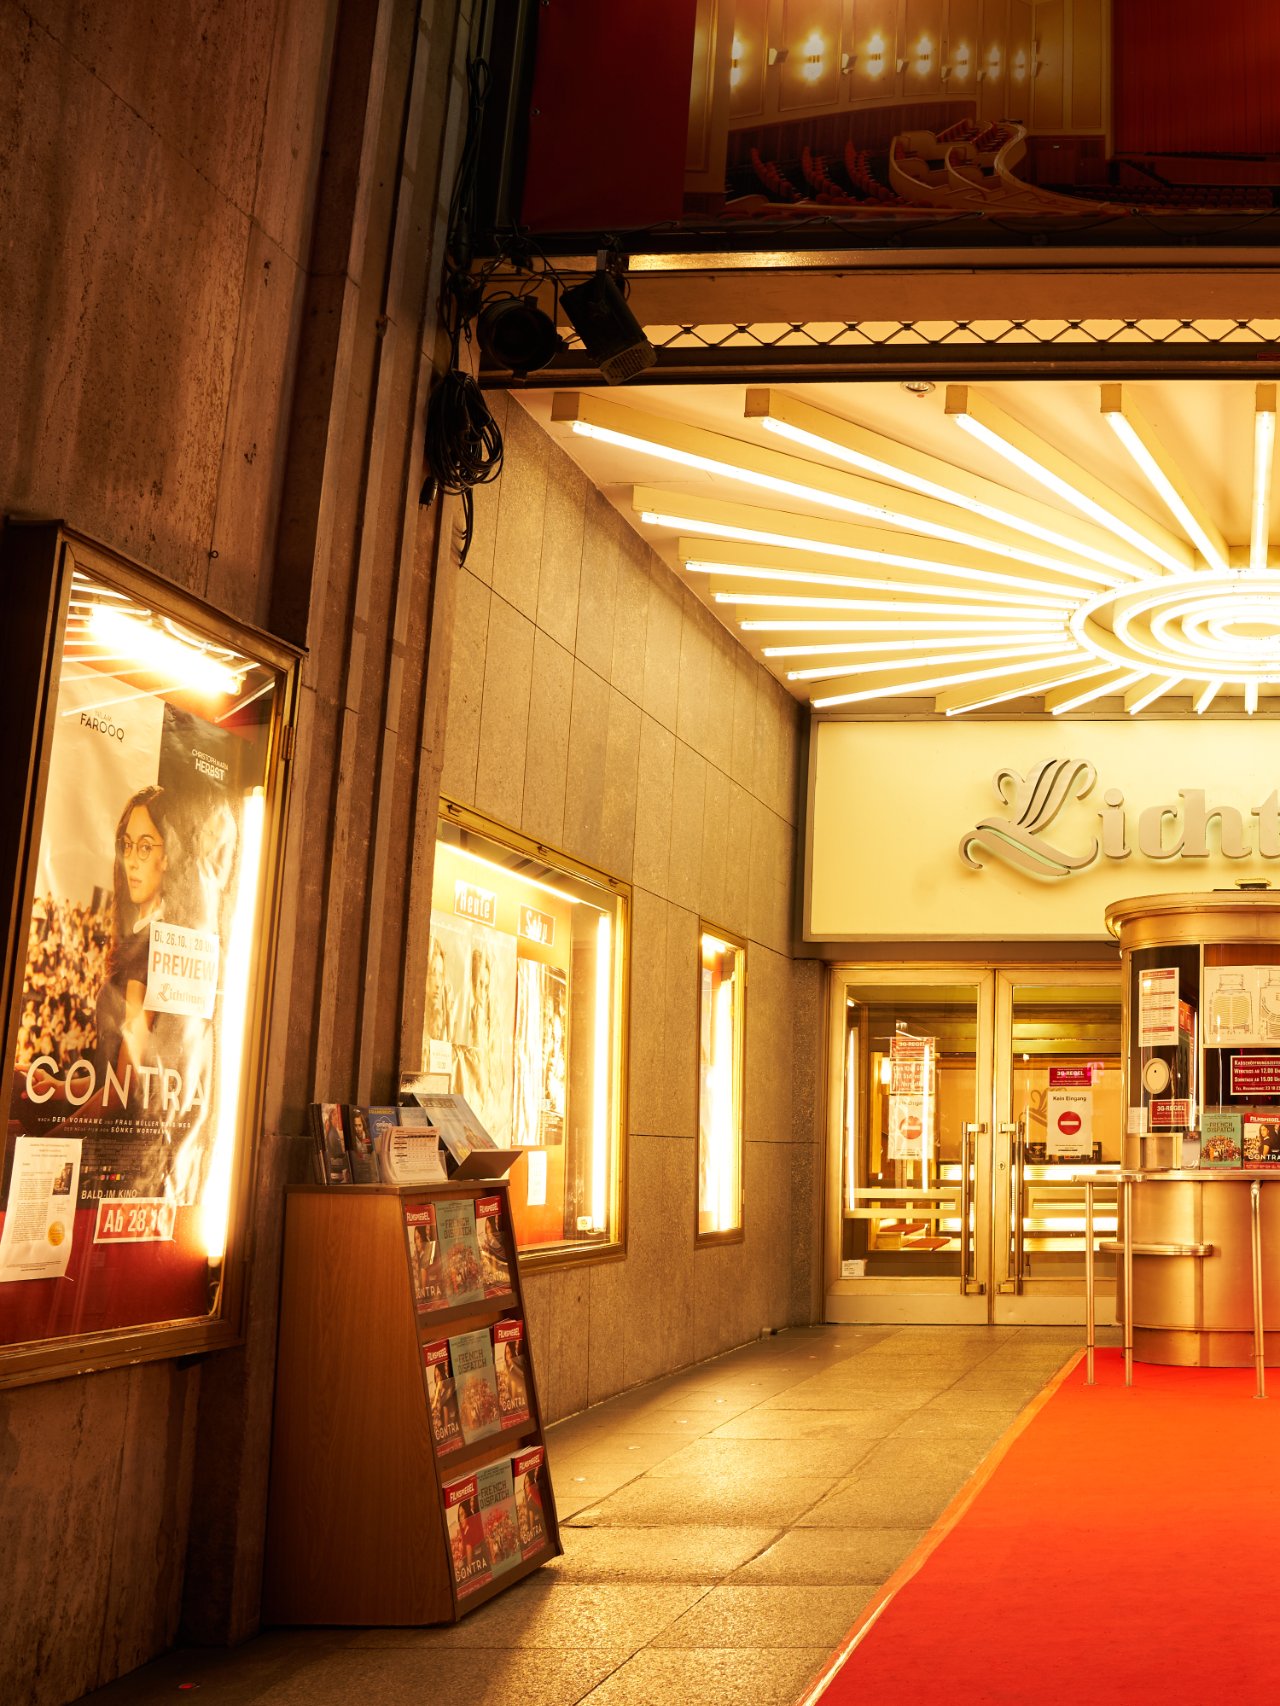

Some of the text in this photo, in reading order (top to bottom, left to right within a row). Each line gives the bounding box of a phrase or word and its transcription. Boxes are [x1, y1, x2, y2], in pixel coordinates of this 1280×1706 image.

[80, 712, 125, 743] FAROOQ
[194, 758, 225, 781] HERBST
[460, 891, 490, 919] Heute
[166, 932, 187, 949] 26.10.
[152, 950, 216, 982] PREVIEW
[26, 1055, 208, 1112] CONTRA
[69, 1117, 103, 1125] VORNAME
[135, 1119, 160, 1127] MÜLLER
[110, 1126, 134, 1134] SÖNKE
[81, 1189, 138, 1200] BALD IM KINO
[103, 1209, 124, 1233] Ab
[502, 1396, 526, 1411] CONTRA
[434, 1423, 459, 1441] CONTRA
[449, 1483, 475, 1502] FILMSPIEGEL
[480, 1480, 507, 1497] FRENCH
[523, 1523, 543, 1545] CONTRA
[455, 1557, 488, 1583] CONTRA
